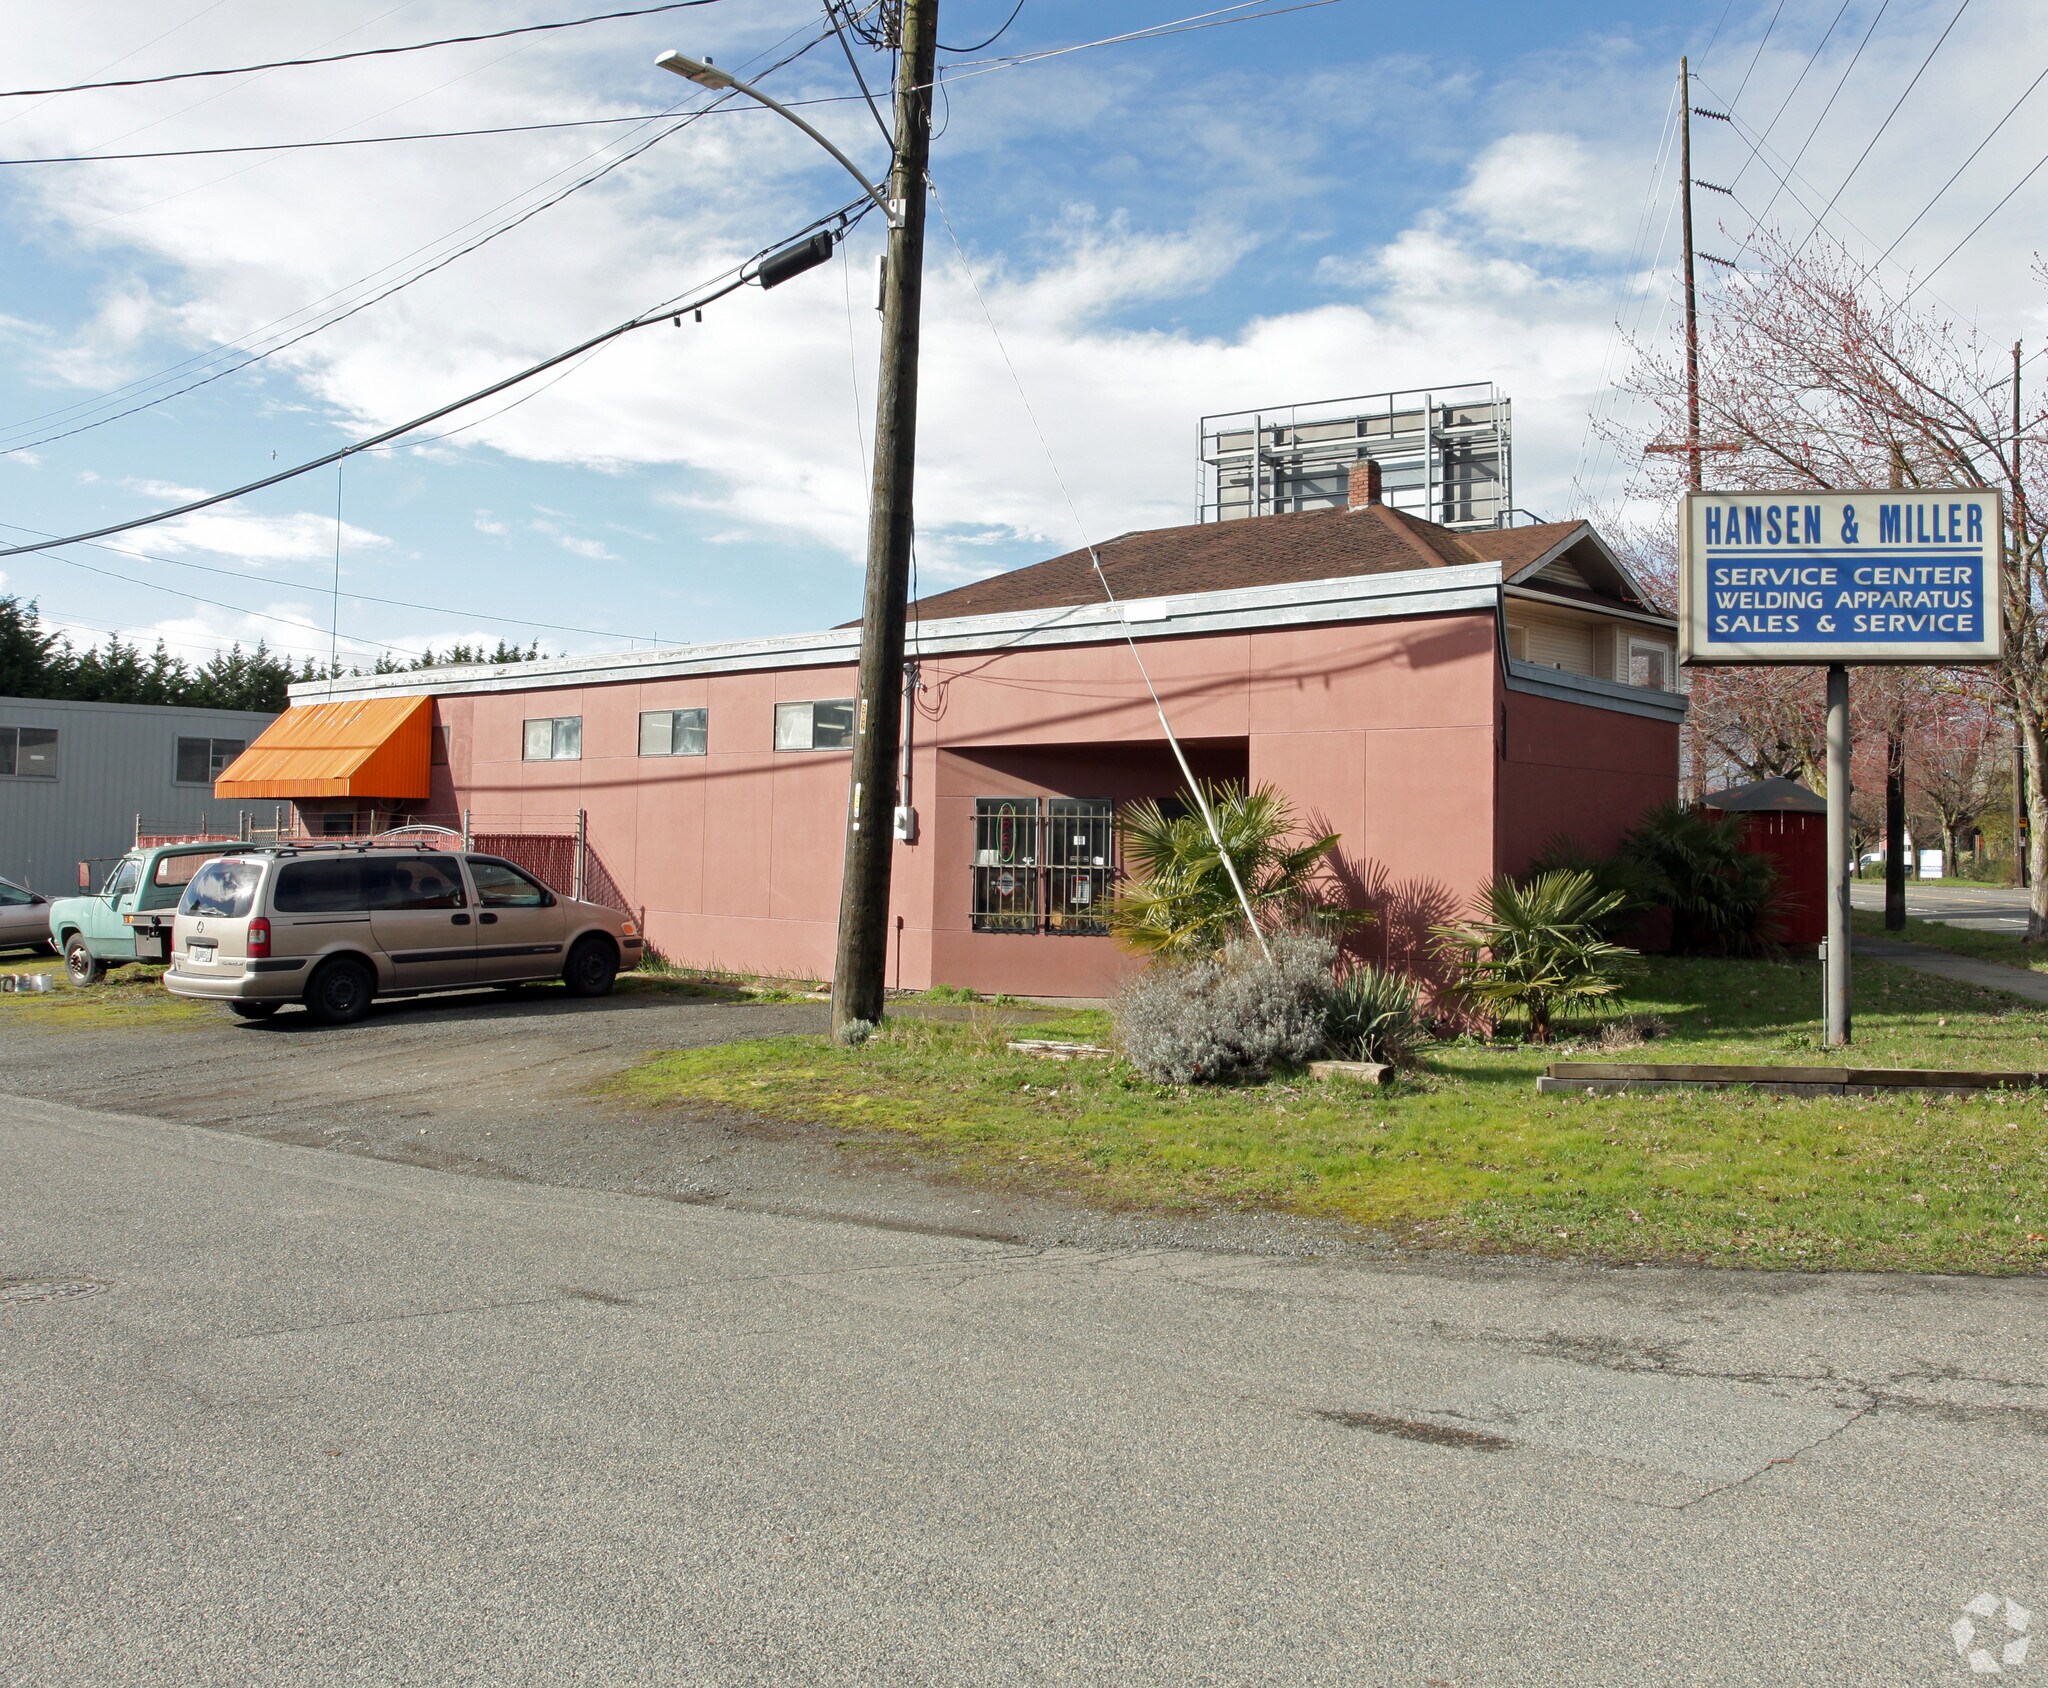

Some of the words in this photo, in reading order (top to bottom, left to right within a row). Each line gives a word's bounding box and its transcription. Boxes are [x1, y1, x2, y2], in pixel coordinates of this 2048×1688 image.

[1706, 505, 1821, 545] HANSEN
[1841, 504, 1859, 544] &
[1879, 504, 1983, 543] MILLER
[1714, 567, 1838, 586] SERVICE
[1853, 566, 1973, 585] CENTER
[1715, 591, 1823, 609] WELDING
[1835, 590, 1973, 608] APPARATUS
[1715, 615, 1800, 633] SALES
[1816, 614, 1836, 633] &
[1853, 614, 1973, 632] SERVICE
